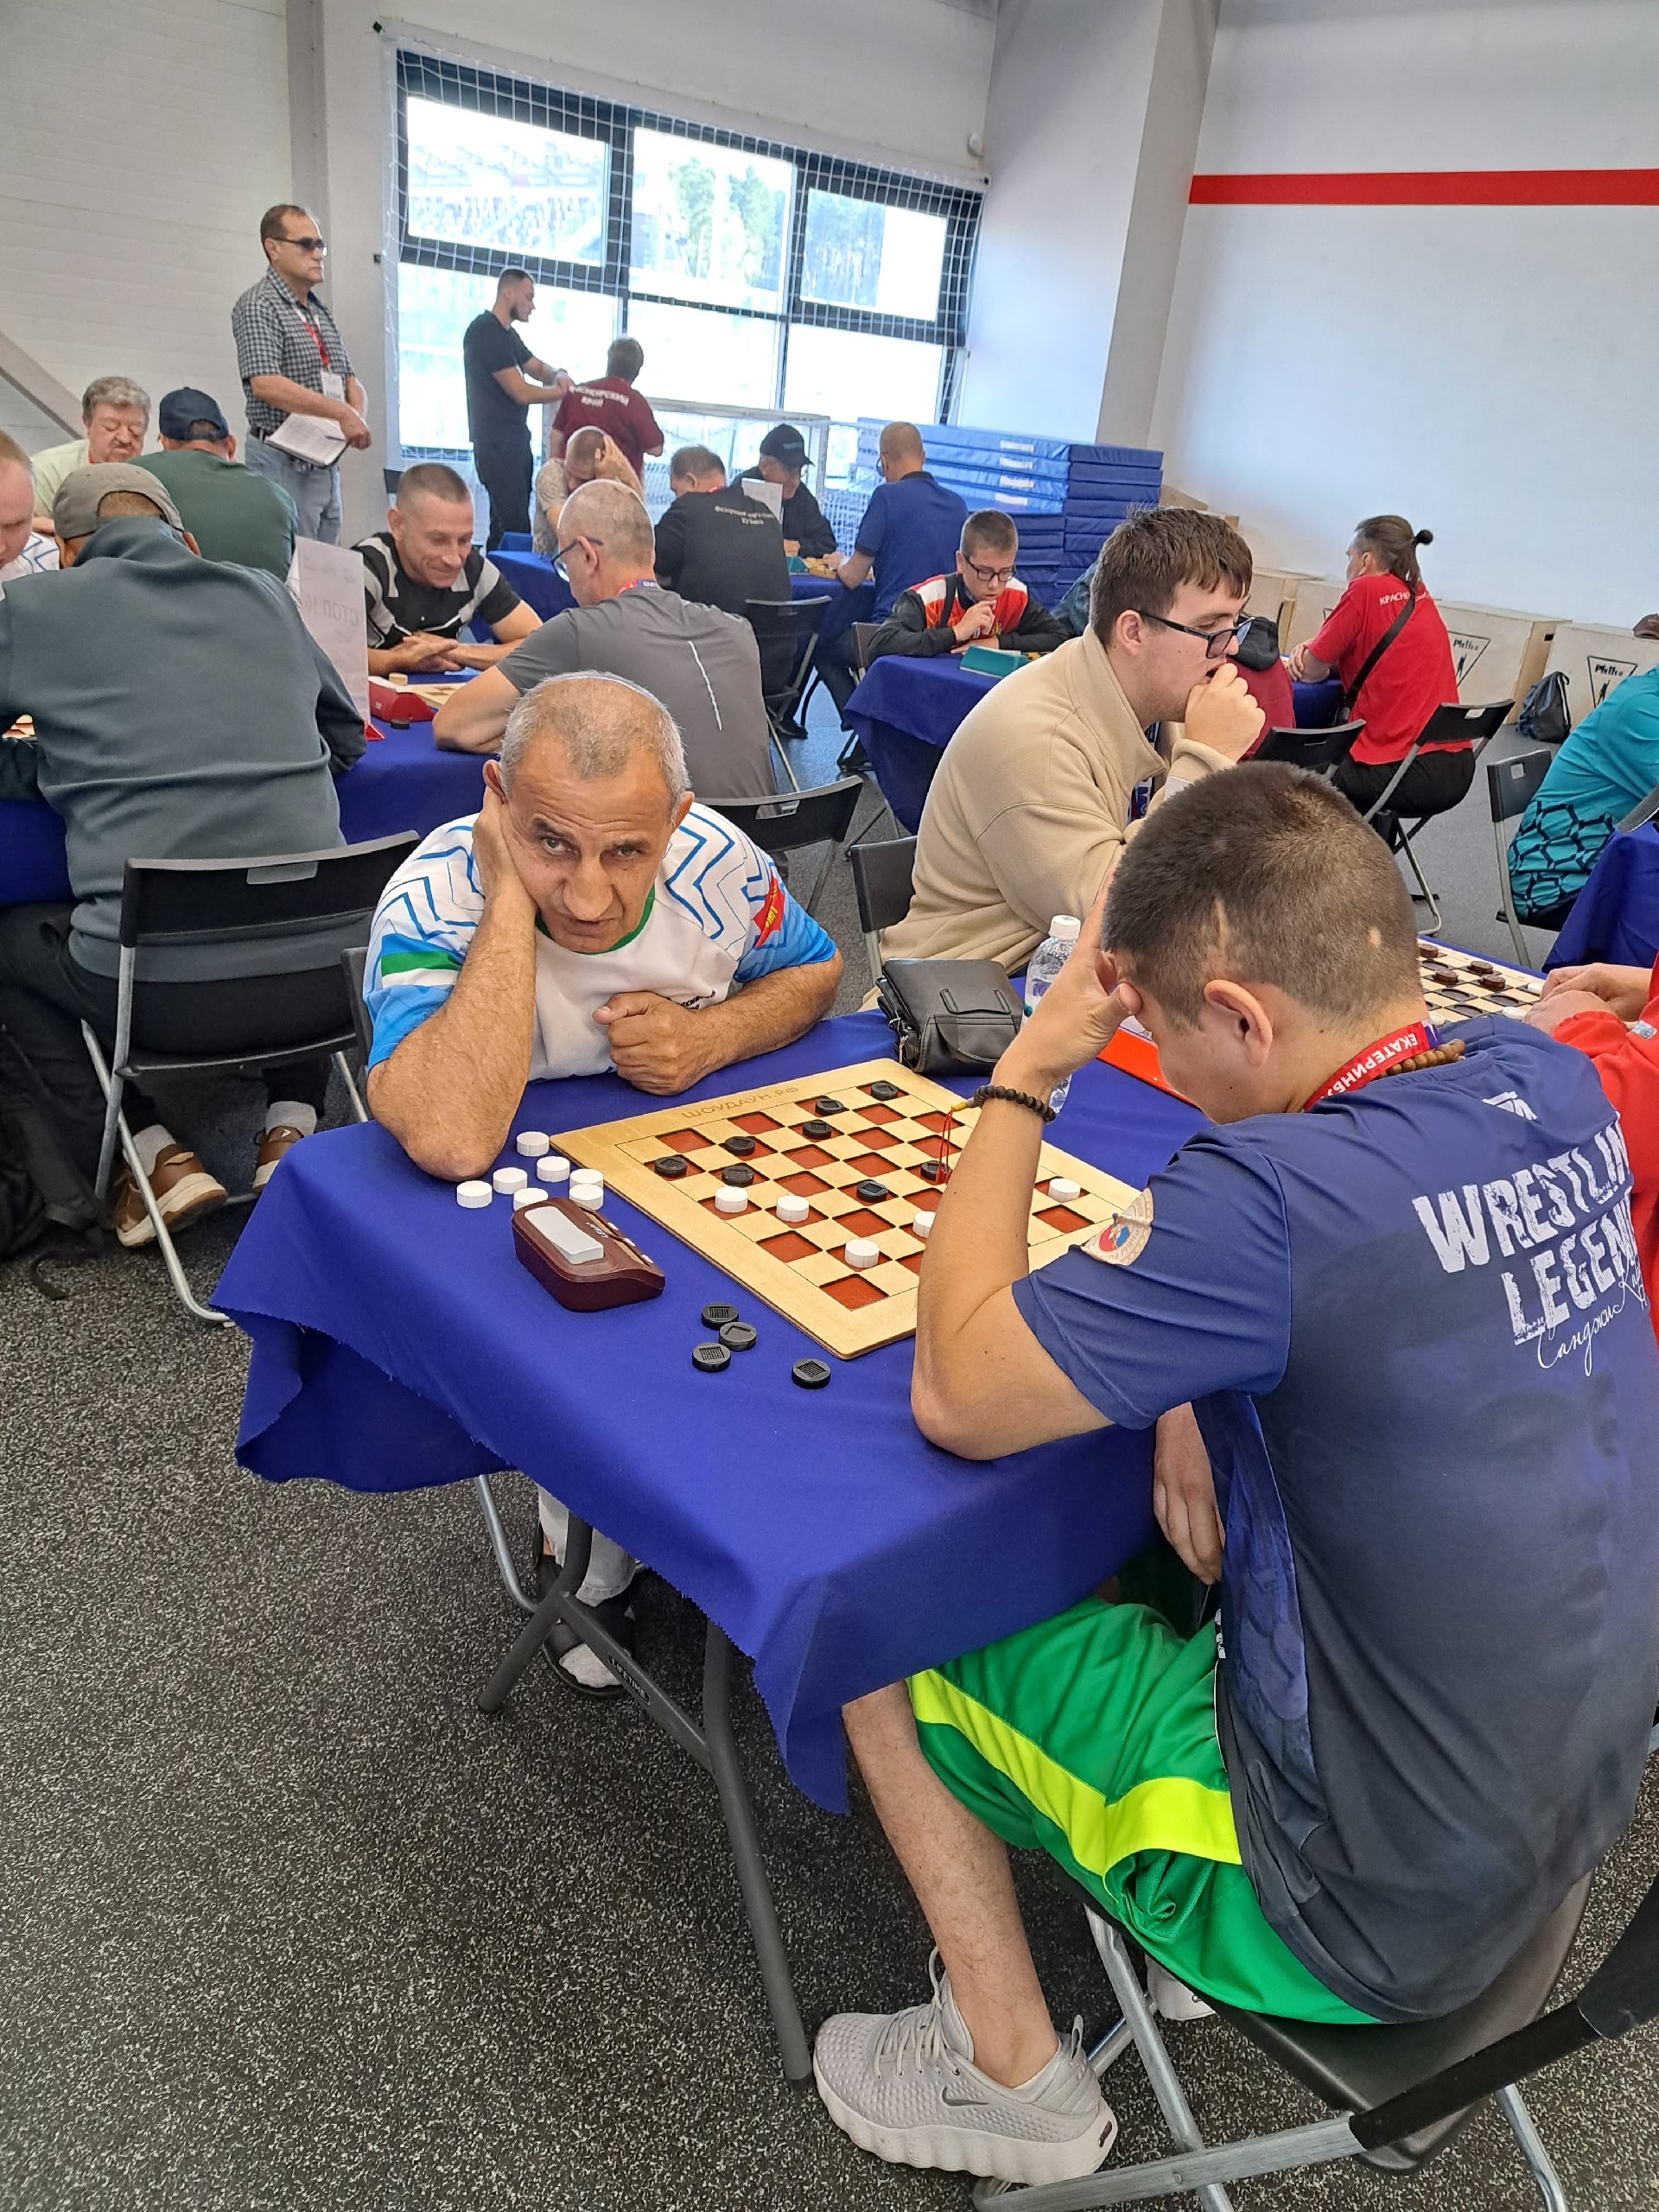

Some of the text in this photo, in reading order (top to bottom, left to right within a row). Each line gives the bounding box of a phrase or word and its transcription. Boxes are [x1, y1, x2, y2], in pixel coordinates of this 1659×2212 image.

[682, 1086, 799, 1119] ШОУДАУН.РФ
[1411, 1121, 1631, 1274] WRESTLIN
[612, 1657, 645, 1699] LIFETIME
